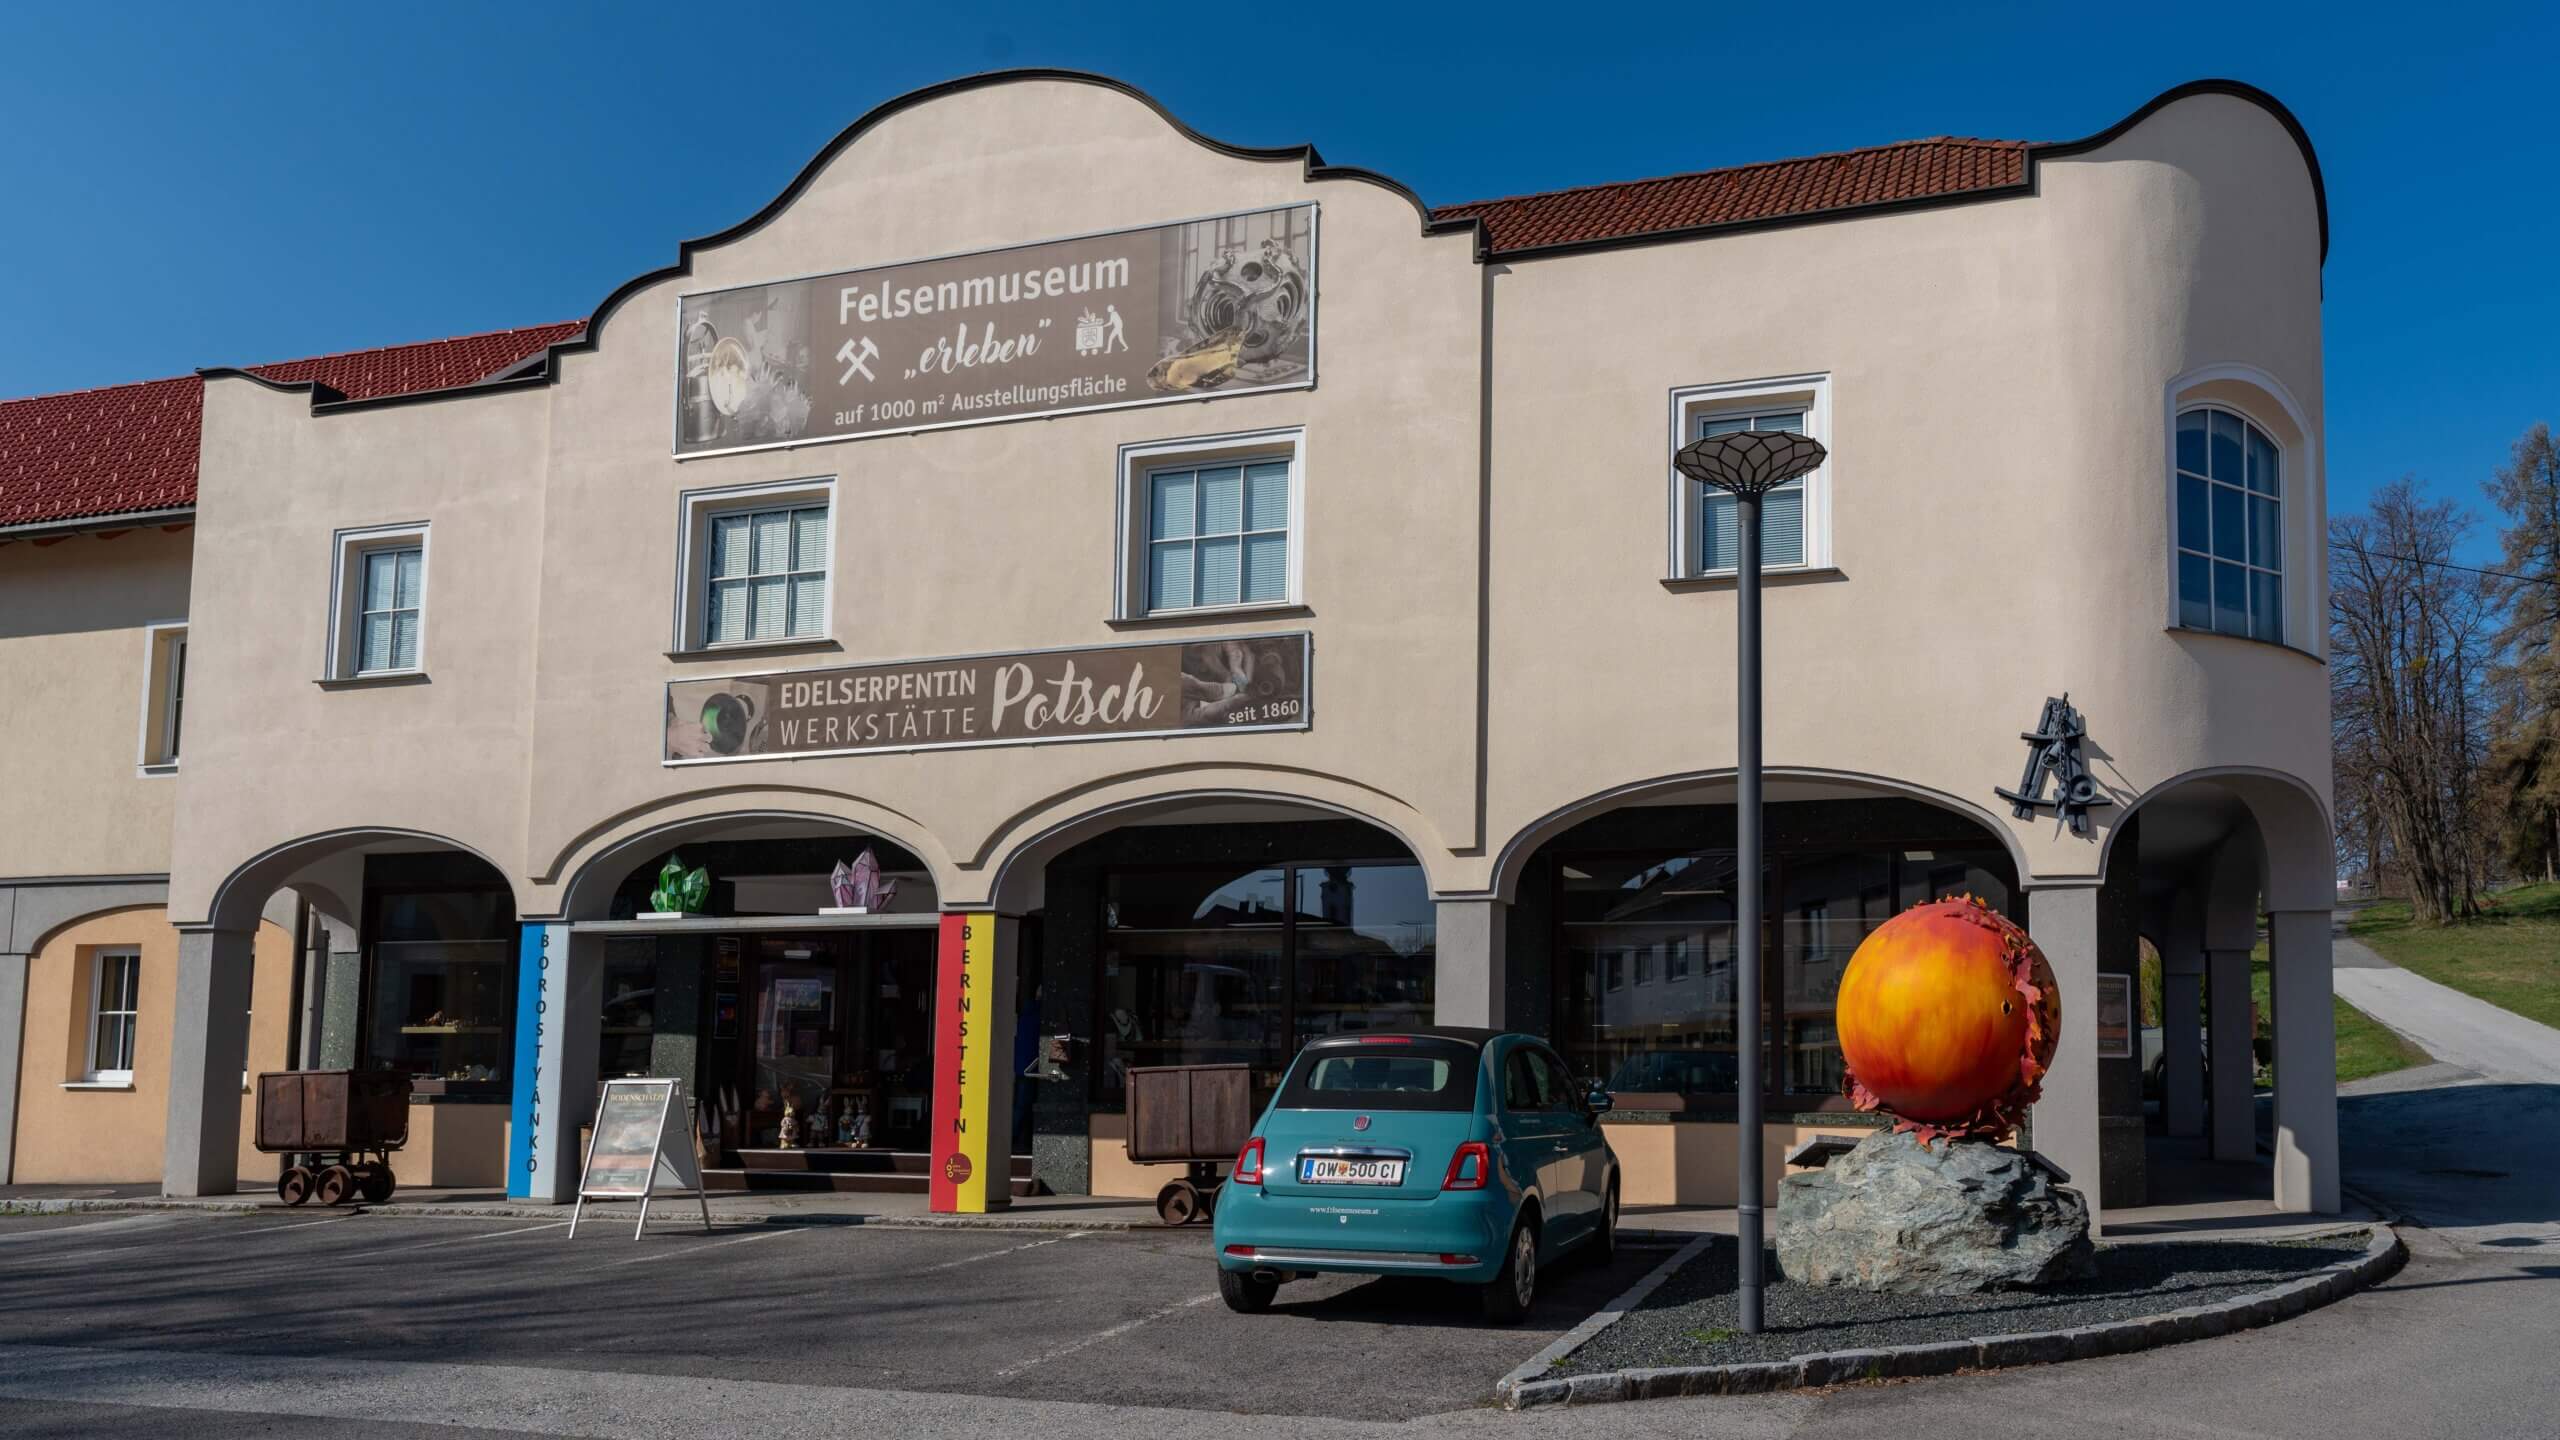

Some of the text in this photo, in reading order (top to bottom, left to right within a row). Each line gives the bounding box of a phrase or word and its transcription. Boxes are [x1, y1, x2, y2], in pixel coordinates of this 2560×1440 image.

[840, 258, 1128, 325] Felsenmuseum
[835, 405, 864, 425] auf
[871, 399, 915, 421] 1000
[952, 375, 1127, 411] Ausstellungsfläche
[780, 669, 976, 708] EDELSERPENTIN
[991, 659, 1165, 733] Potsch
[780, 706, 976, 746] WERKSTÄTTE
[1228, 700, 1300, 724] seit 1860
[954, 925, 972, 1133] BERNSTEIN
[1316, 1162, 1338, 1177] OW
[1349, 1163, 1377, 1178] 500
